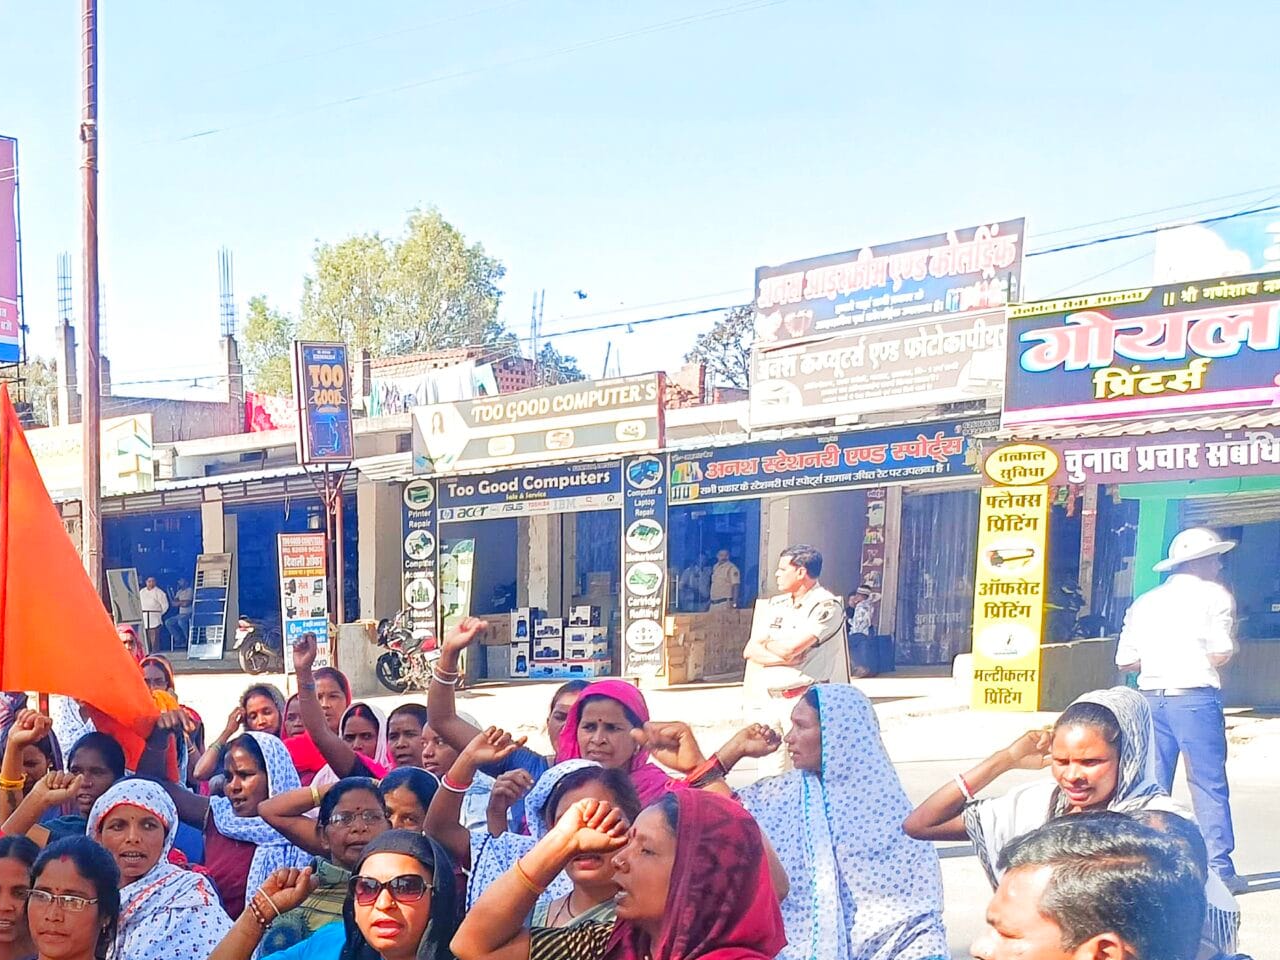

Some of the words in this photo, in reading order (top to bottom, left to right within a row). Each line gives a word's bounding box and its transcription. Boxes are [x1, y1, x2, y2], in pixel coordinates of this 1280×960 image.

[1181, 286, 1198, 303] श्री
[1203, 281, 1259, 299] गणेशाय
[1019, 310, 1280, 373] गोयल
[308, 364, 344, 388] TOO
[1092, 358, 1211, 399] प्रिंटर्स
[471, 404, 505, 423] TOO
[506, 397, 550, 422] GOOD
[553, 382, 657, 412] COMPUTER'S
[762, 443, 840, 473] स्टेशनरी
[844, 444, 889, 466] एण्ड
[891, 431, 965, 463] स्पोर्ट्स
[1063, 447, 1131, 483] चुनाव
[1136, 443, 1200, 472] प्रचार
[718, 484, 739, 494] प्रकार
[740, 482, 748, 491] के
[890, 469, 901, 477] पर
[1000, 466, 1045, 482] सुविधा
[448, 484, 474, 498] Too
[479, 477, 518, 494] Good
[523, 471, 610, 491] Computers
[634, 496, 655, 507] Laptop
[408, 510, 431, 518] Printer
[457, 506, 489, 518] acer
[635, 508, 655, 518] Repair
[409, 520, 431, 529] Repair
[987, 514, 1038, 532] प्रिंटिंग
[979, 578, 1041, 596] ऑफसेट
[984, 601, 1031, 618] प्रिंटिंग
[974, 665, 1036, 683] मल्टीकलर
[984, 688, 1022, 705] प्रिंटिंग
